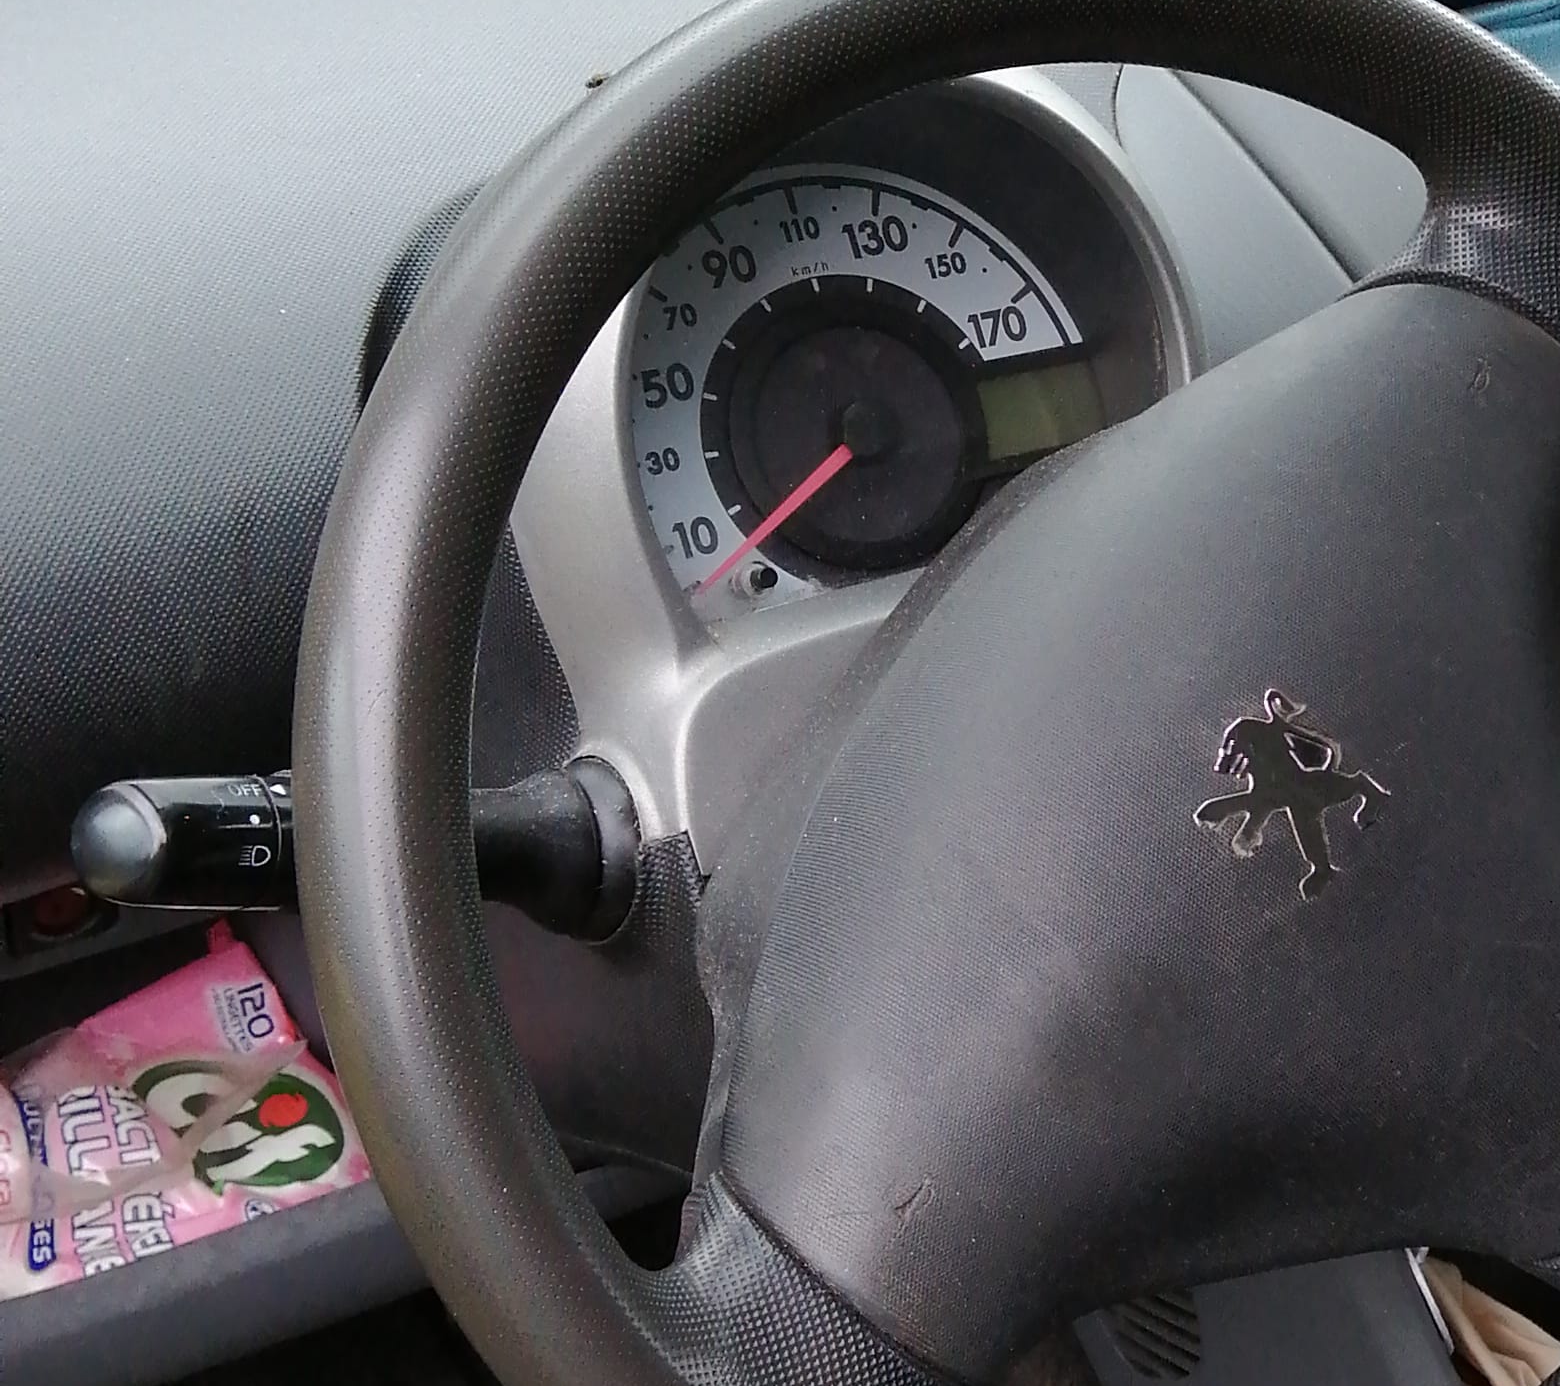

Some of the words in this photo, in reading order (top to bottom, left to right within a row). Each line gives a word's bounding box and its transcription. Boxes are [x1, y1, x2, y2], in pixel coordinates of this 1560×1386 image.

[779, 216, 820, 243] 110
[841, 215, 909, 259] 130
[702, 245, 757, 289] 90
[791, 261, 829, 277] km/h
[924, 251, 967, 279] 150
[663, 303, 698, 331] 70
[967, 305, 1028, 349] 170
[640, 363, 694, 409] 50
[645, 447, 680, 476] 30
[672, 516, 718, 559] 10
[226, 782, 262, 797] OFF
[238, 982, 274, 1038] 120
